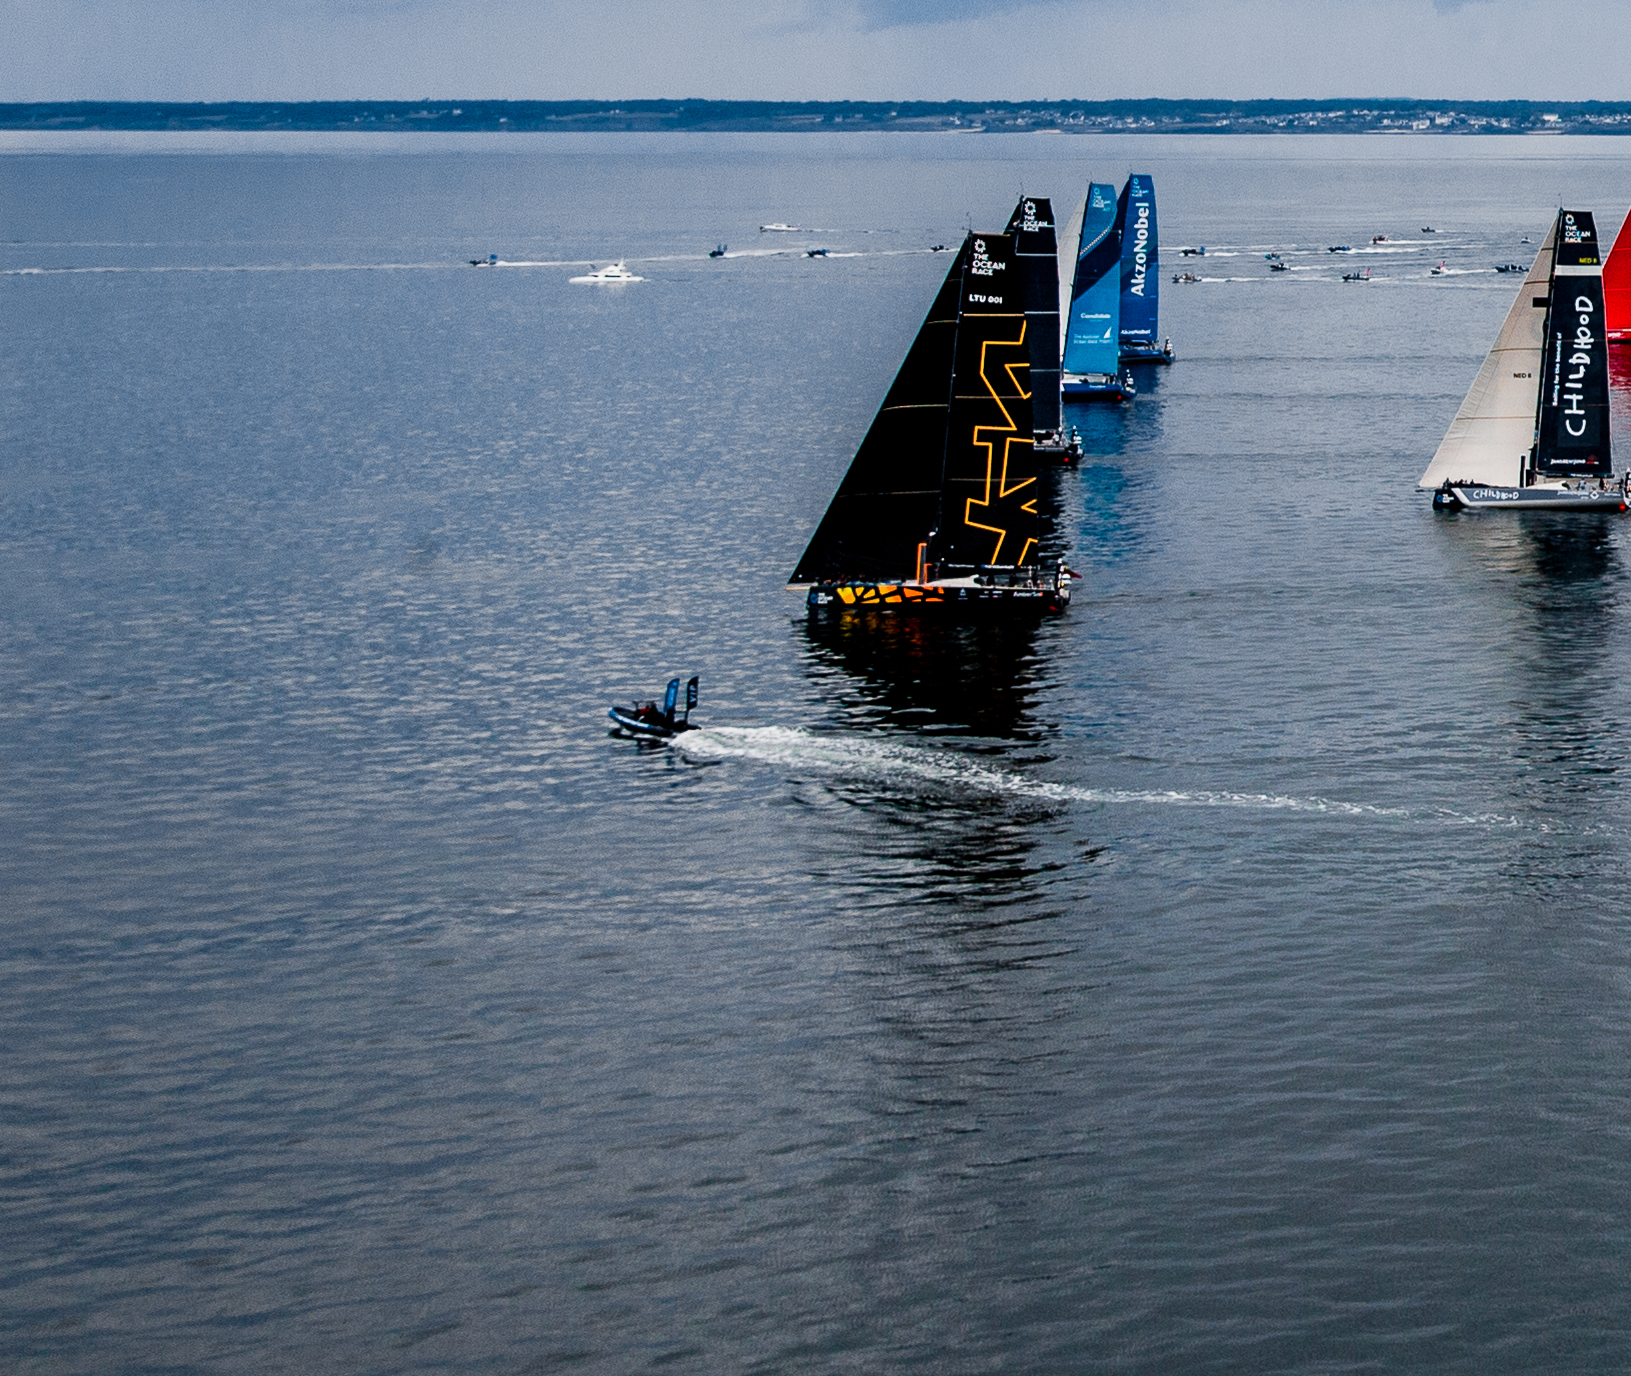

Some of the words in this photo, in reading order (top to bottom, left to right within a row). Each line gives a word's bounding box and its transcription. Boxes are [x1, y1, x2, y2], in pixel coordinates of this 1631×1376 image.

[1130, 202, 1149, 297] AkzoNobel
[972, 260, 1006, 270] OCEAN
[971, 267, 994, 276] RACE
[968, 293, 986, 303] LTU
[1563, 296, 1595, 436] CHILDHOOD
